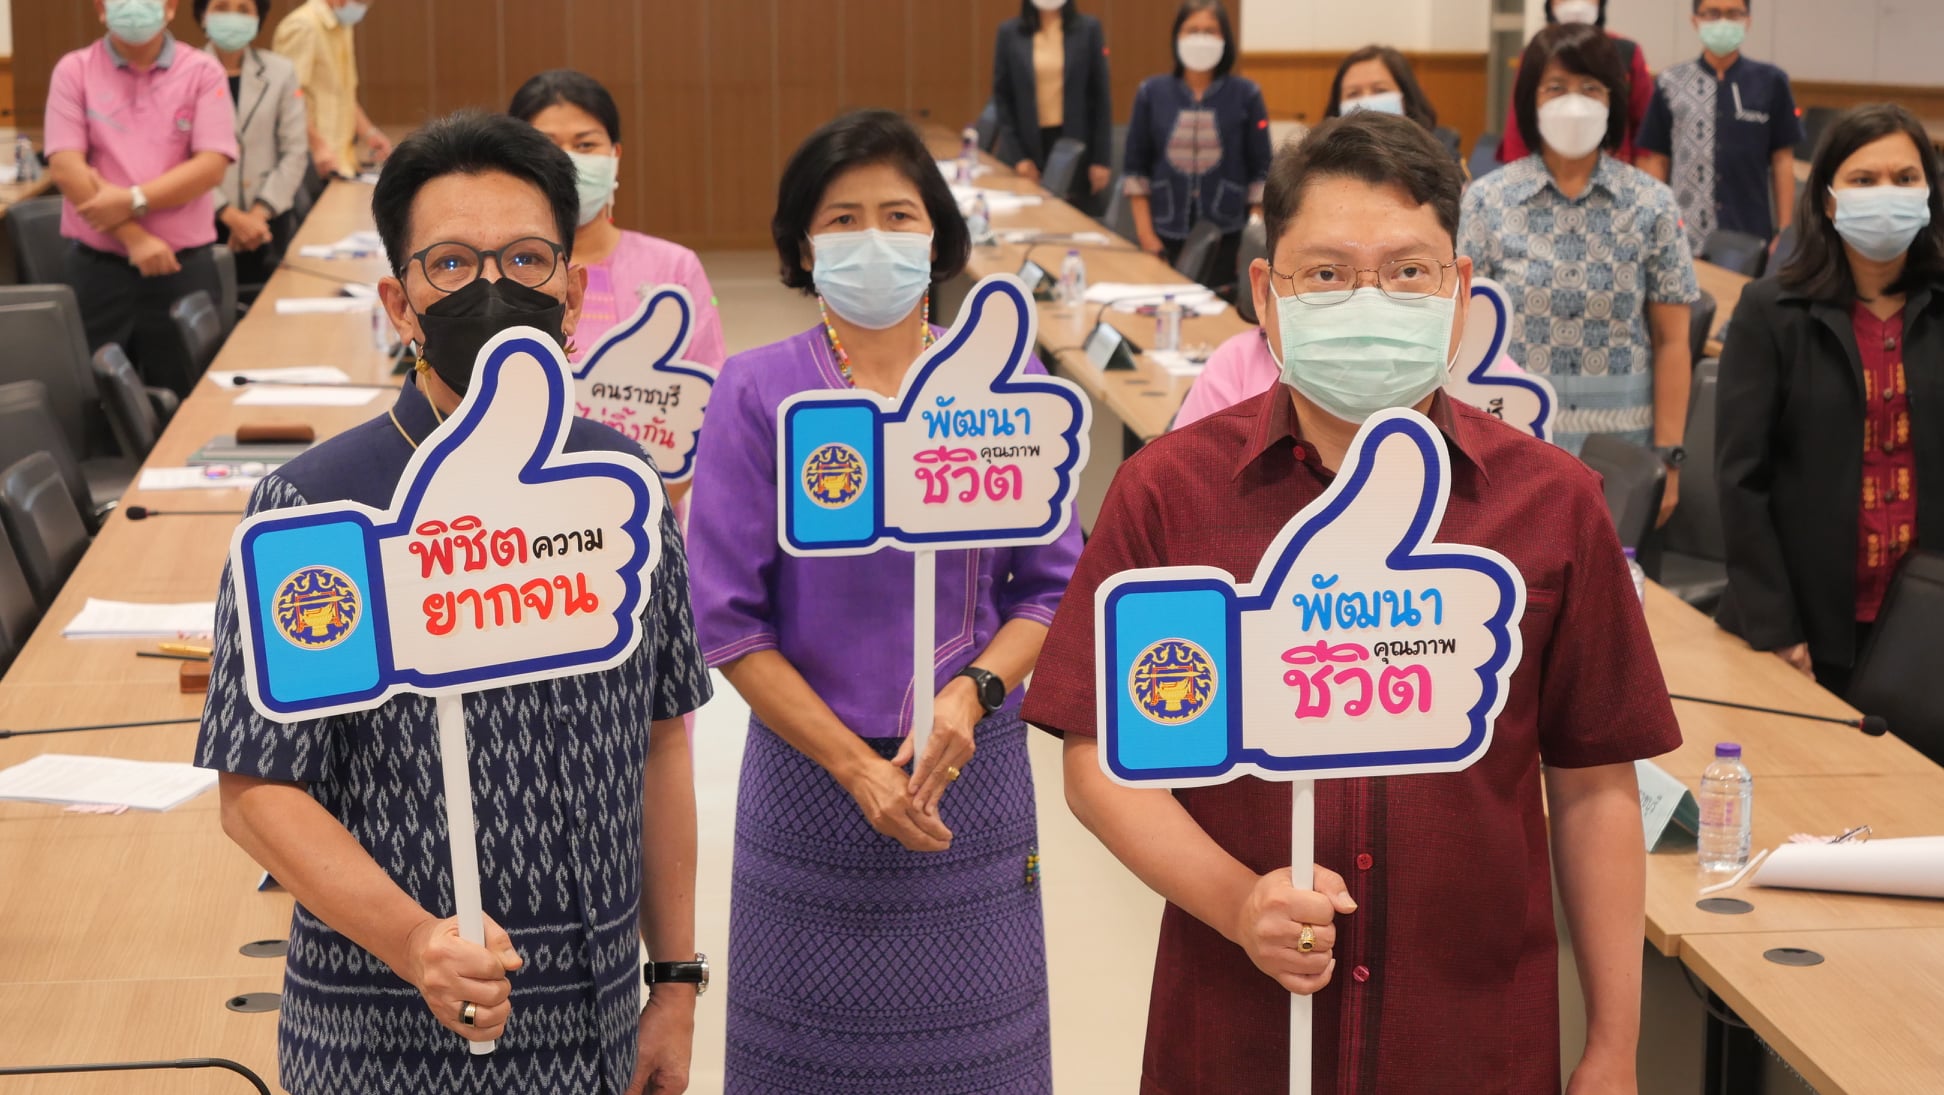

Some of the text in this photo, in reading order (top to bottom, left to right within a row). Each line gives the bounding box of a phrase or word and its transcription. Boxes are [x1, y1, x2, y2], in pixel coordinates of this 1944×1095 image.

[591, 383, 681, 414] คนราชบุรี
[921, 395, 1031, 439] พัฒนา
[913, 445, 1023, 504] ชีวิต
[980, 445, 1040, 464] คุณภาพ
[408, 515, 604, 579] พิชิต ความ
[422, 572, 599, 636] ยากจน
[1292, 573, 1443, 632] พัฒนา
[1281, 639, 1433, 719] ชีวิต
[1373, 638, 1456, 665] คุณภาพ
